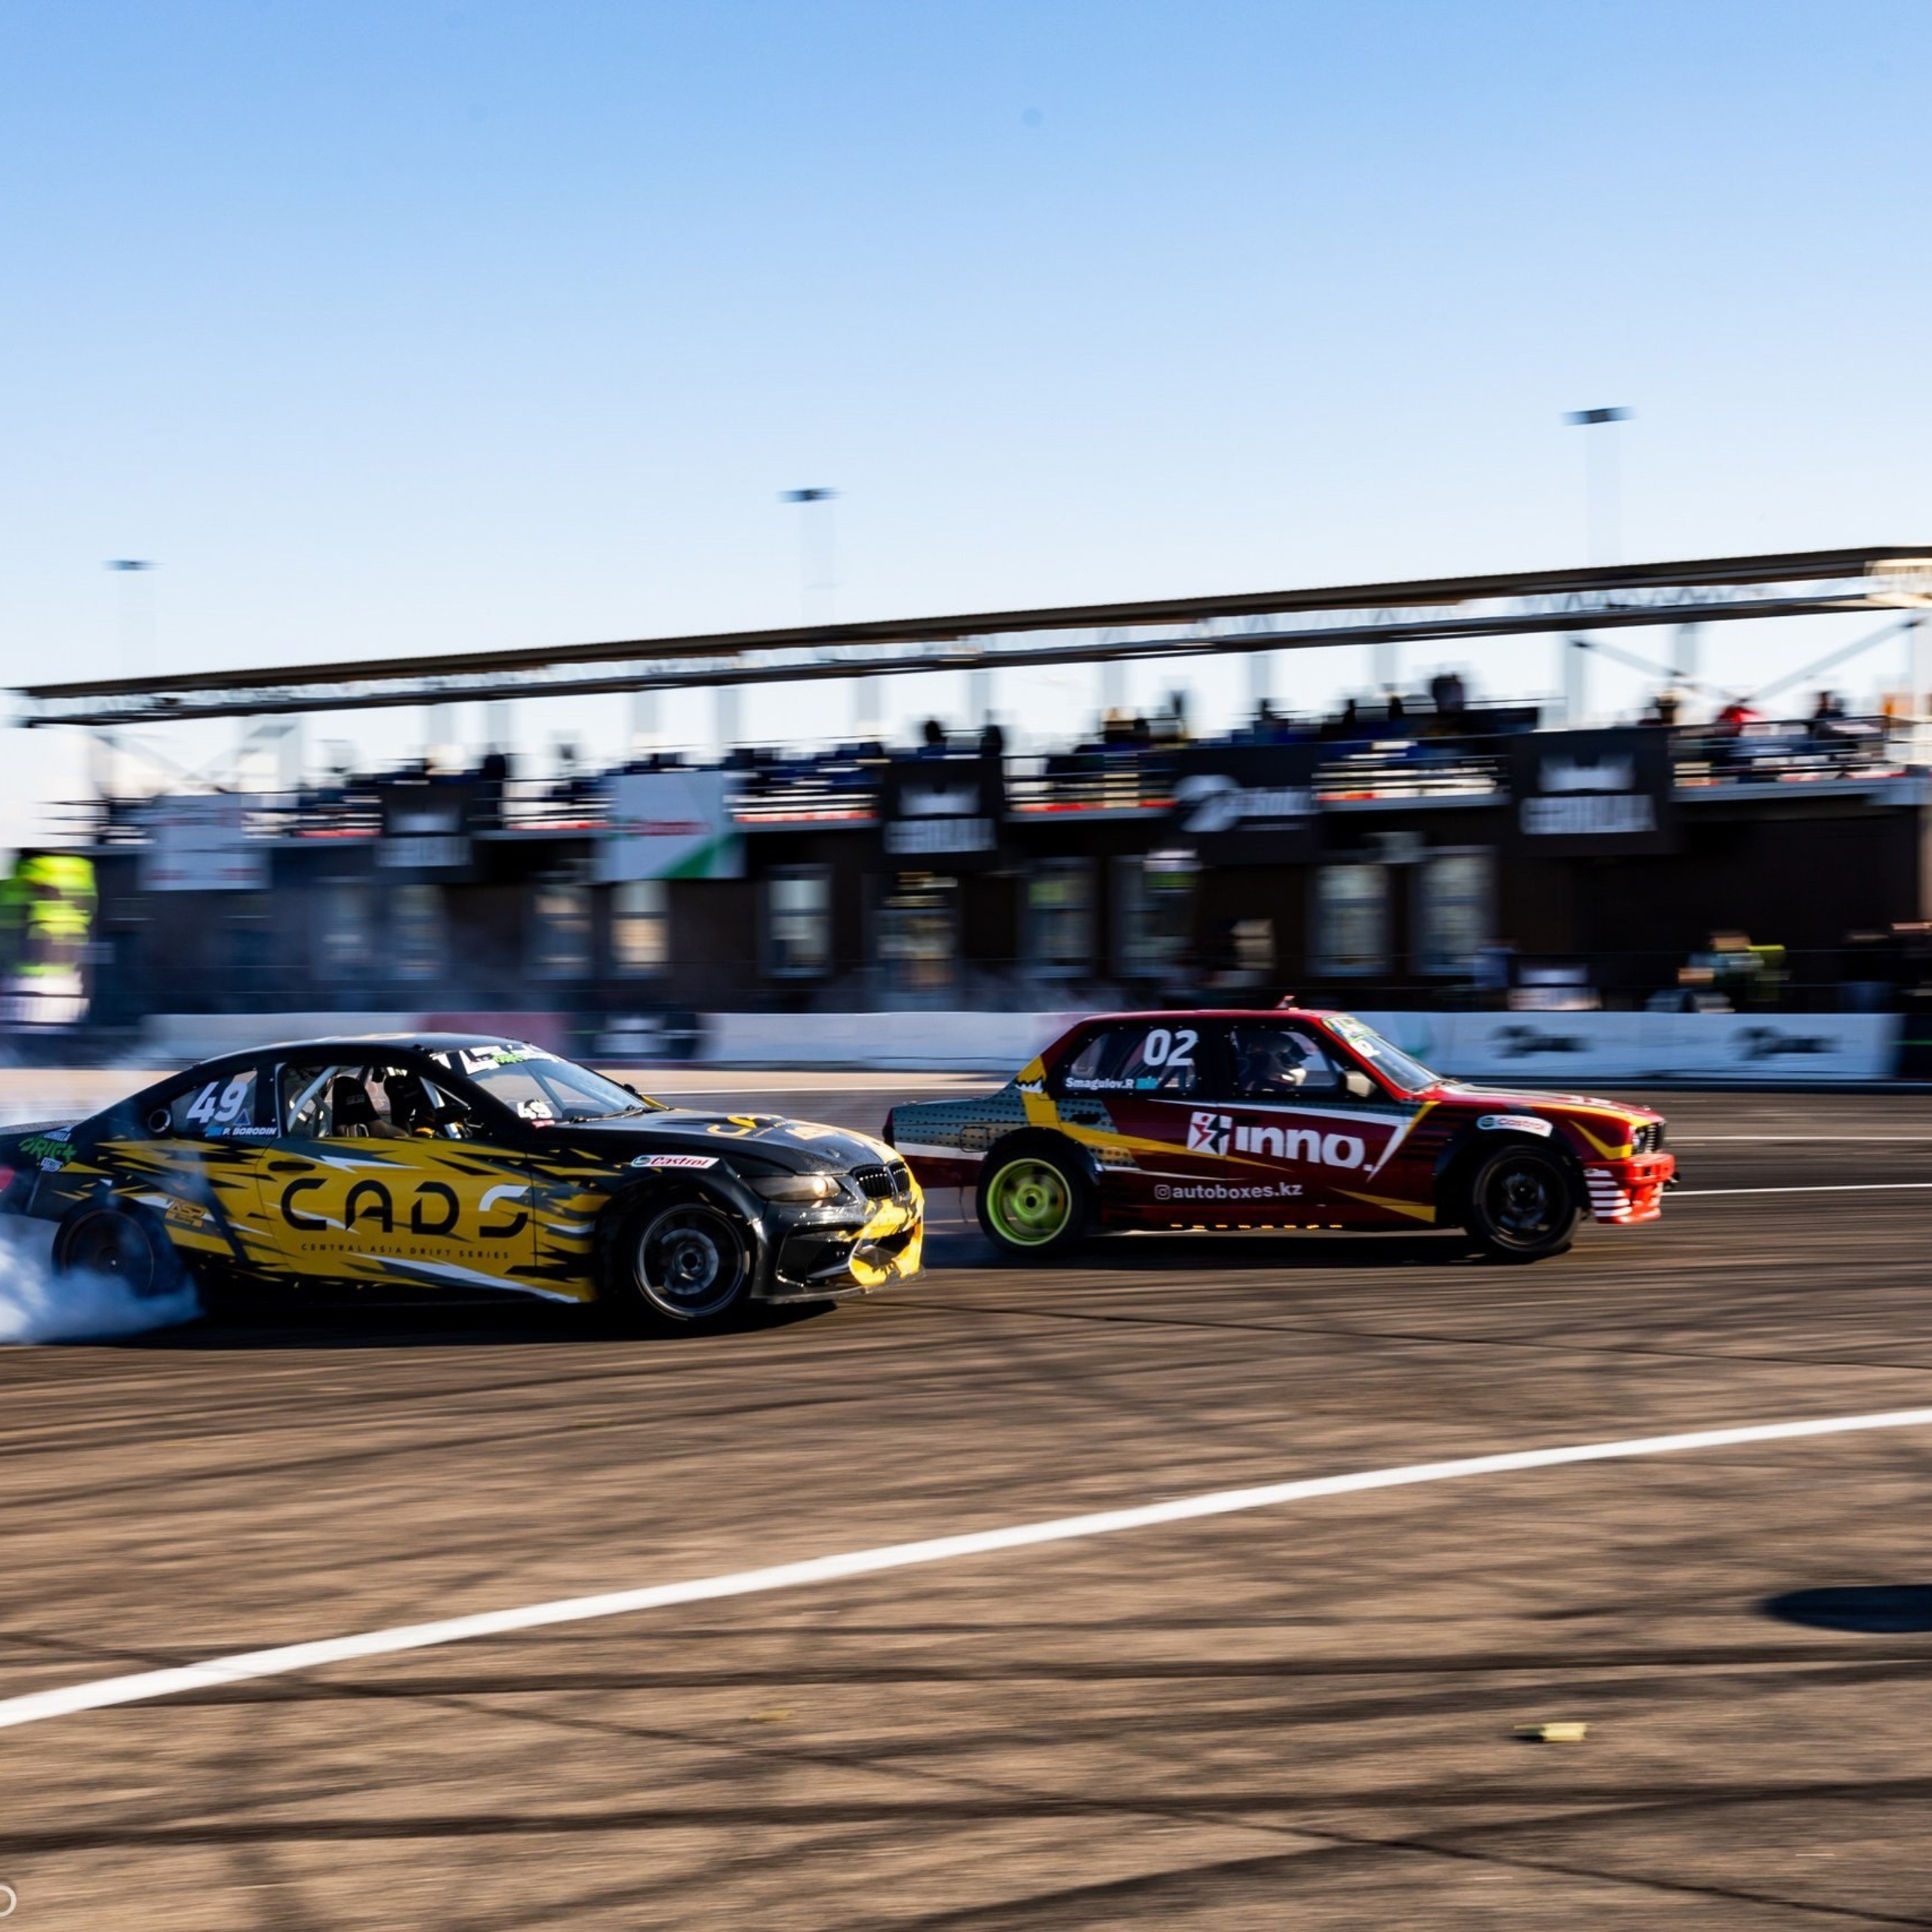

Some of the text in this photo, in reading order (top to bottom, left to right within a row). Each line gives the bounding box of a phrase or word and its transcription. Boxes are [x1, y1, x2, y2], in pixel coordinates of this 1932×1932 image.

[1143, 1029, 1198, 1066] 02
[1065, 1077, 1134, 1090] Smagulov.R
[186, 1081, 248, 1124] 49
[232, 1128, 278, 1136] BORODIN
[650, 1156, 709, 1166] Castrol
[1172, 1182, 1303, 1200] autoboxes.kz
[281, 1178, 529, 1238] CADS
[301, 1244, 509, 1260] CENTRAL ASIA DRIFT SERIES
